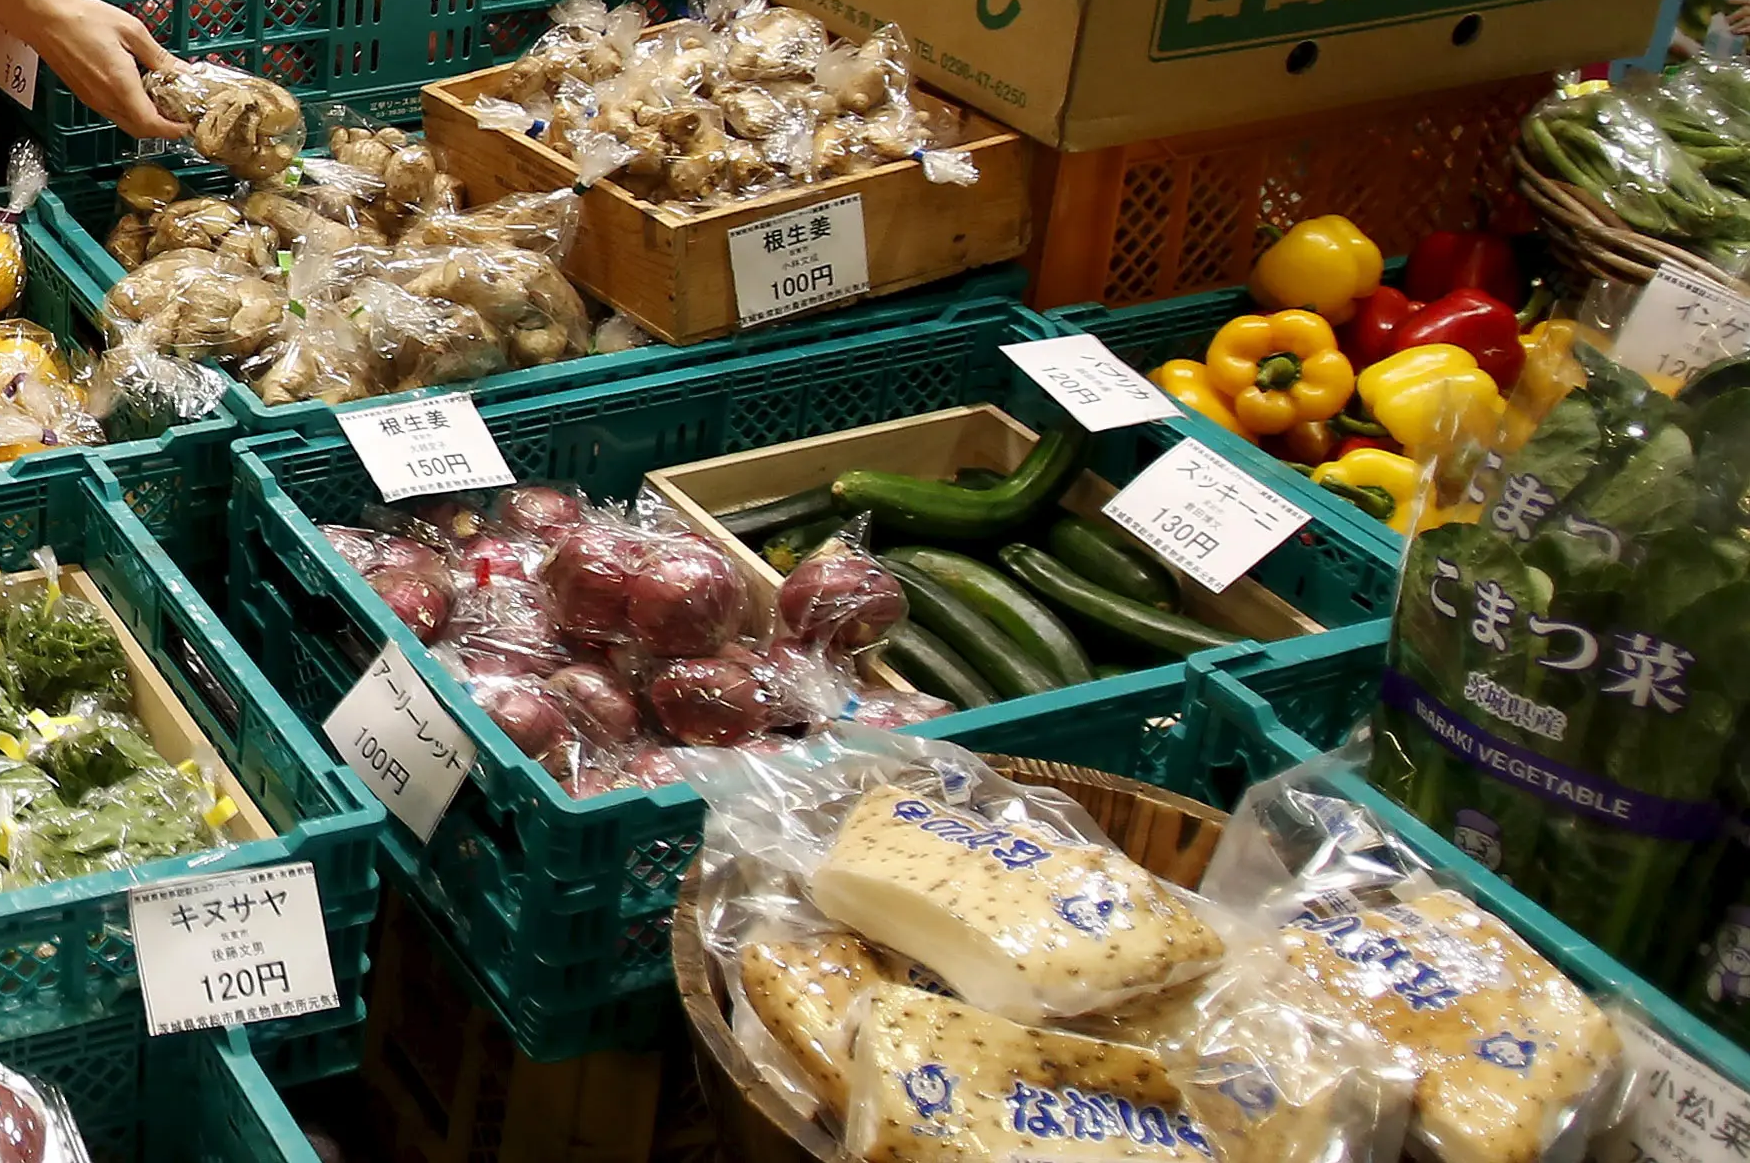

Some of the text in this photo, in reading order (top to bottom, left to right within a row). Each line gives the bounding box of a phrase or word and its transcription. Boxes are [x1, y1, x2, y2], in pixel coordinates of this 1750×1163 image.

[913, 37, 937, 65] TEL
[762, 215, 832, 254] 根生姜
[771, 263, 834, 300] 100円
[1041, 366, 1102, 406] 120円
[1079, 355, 1151, 401] パプリカ
[378, 408, 452, 438] 根生姜
[406, 453, 472, 478] 150円
[1175, 459, 1280, 533] ズッキーニ
[1149, 506, 1221, 560] 130円
[1428, 555, 1698, 716] こまつ菜
[372, 657, 462, 771] アーリーレット
[1463, 669, 1568, 742] 茨城県産
[353, 726, 411, 796] 100円
[1415, 696, 1635, 823] IBARAKI VEGETABLE
[170, 889, 289, 933] キヌサヤ
[211, 941, 266, 963] 後藤文男
[200, 960, 291, 1004] 120円
[1649, 1068, 1750, 1160] 小松菜
